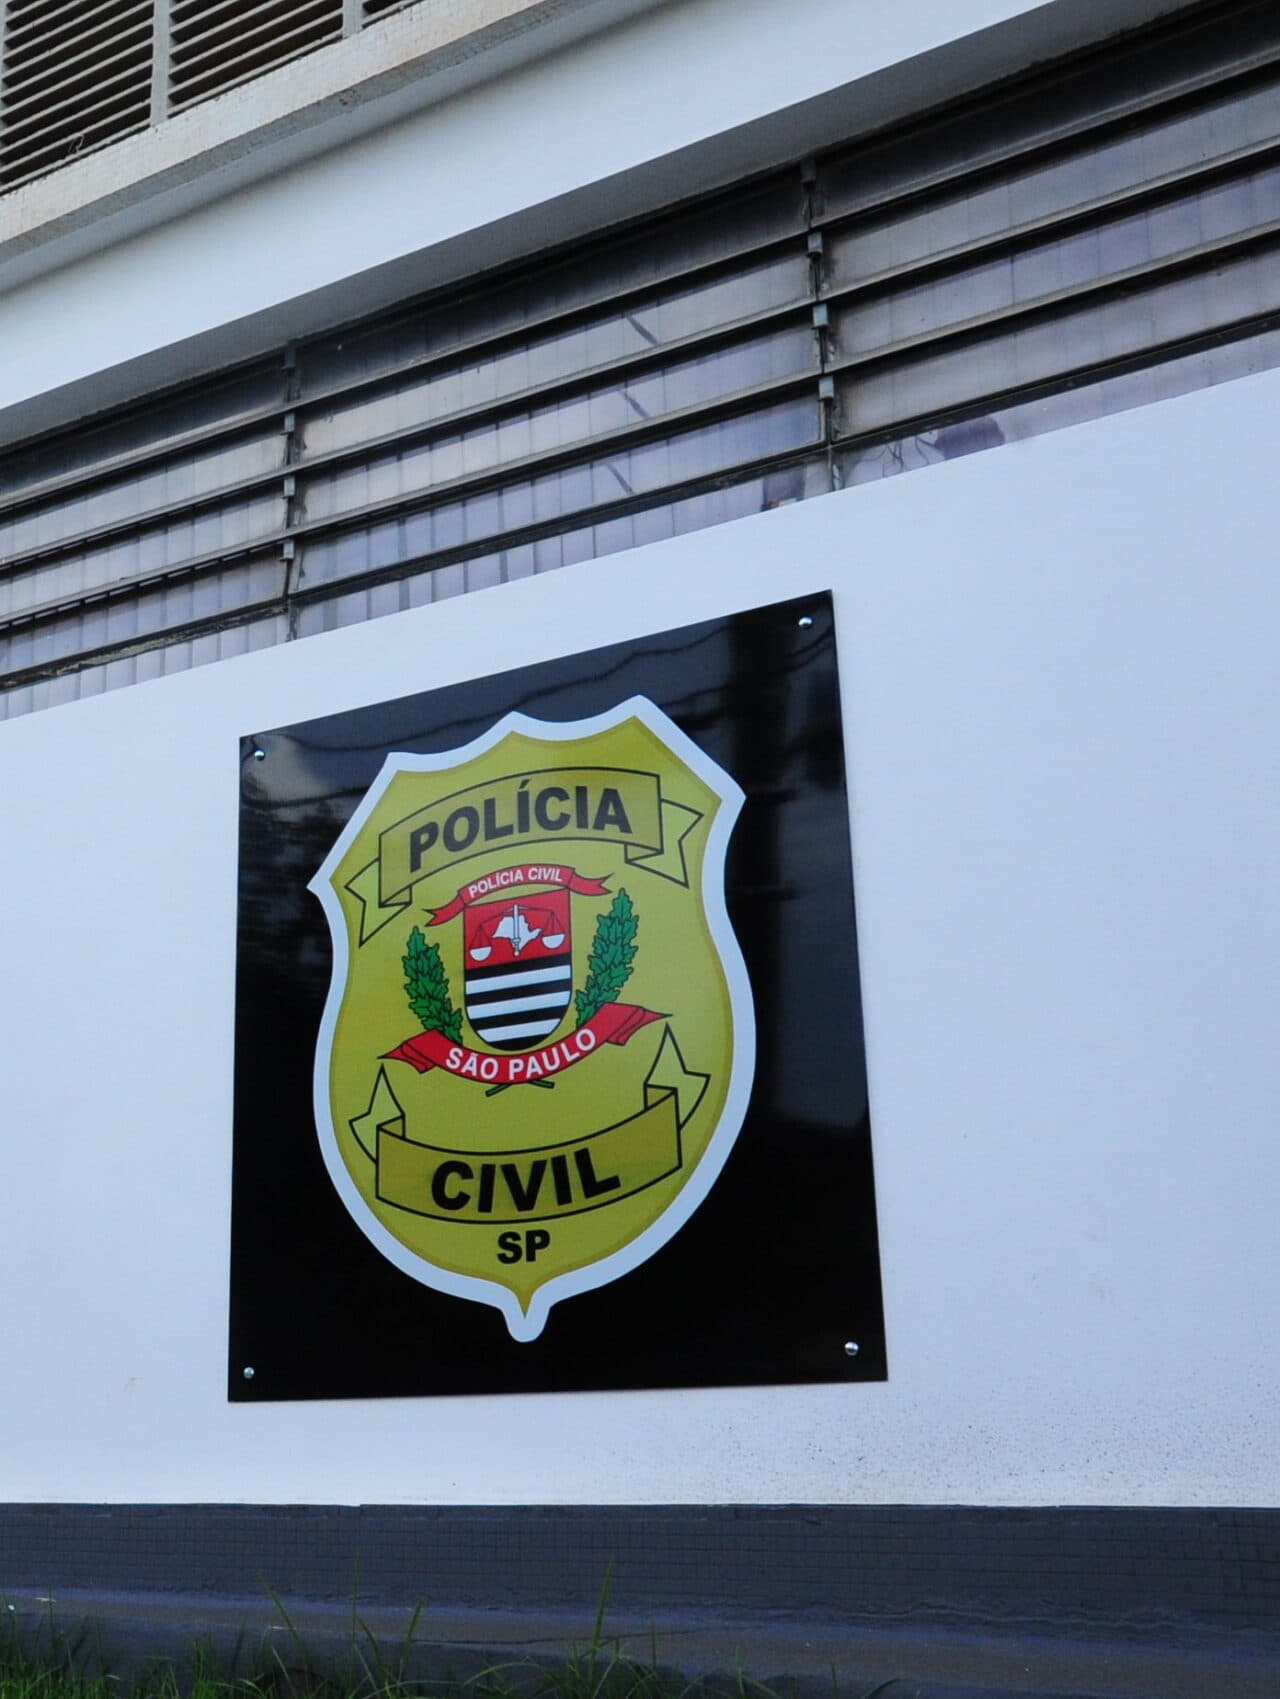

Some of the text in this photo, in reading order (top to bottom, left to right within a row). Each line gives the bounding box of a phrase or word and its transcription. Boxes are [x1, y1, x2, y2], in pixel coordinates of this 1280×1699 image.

[409, 779, 633, 874] POLÍCIA
[468, 866, 564, 898] POLÍCIA CIVIL
[445, 1028, 596, 1081] SÃO PAULO
[431, 1148, 622, 1214] CIVIL
[497, 1229, 551, 1265] SP
